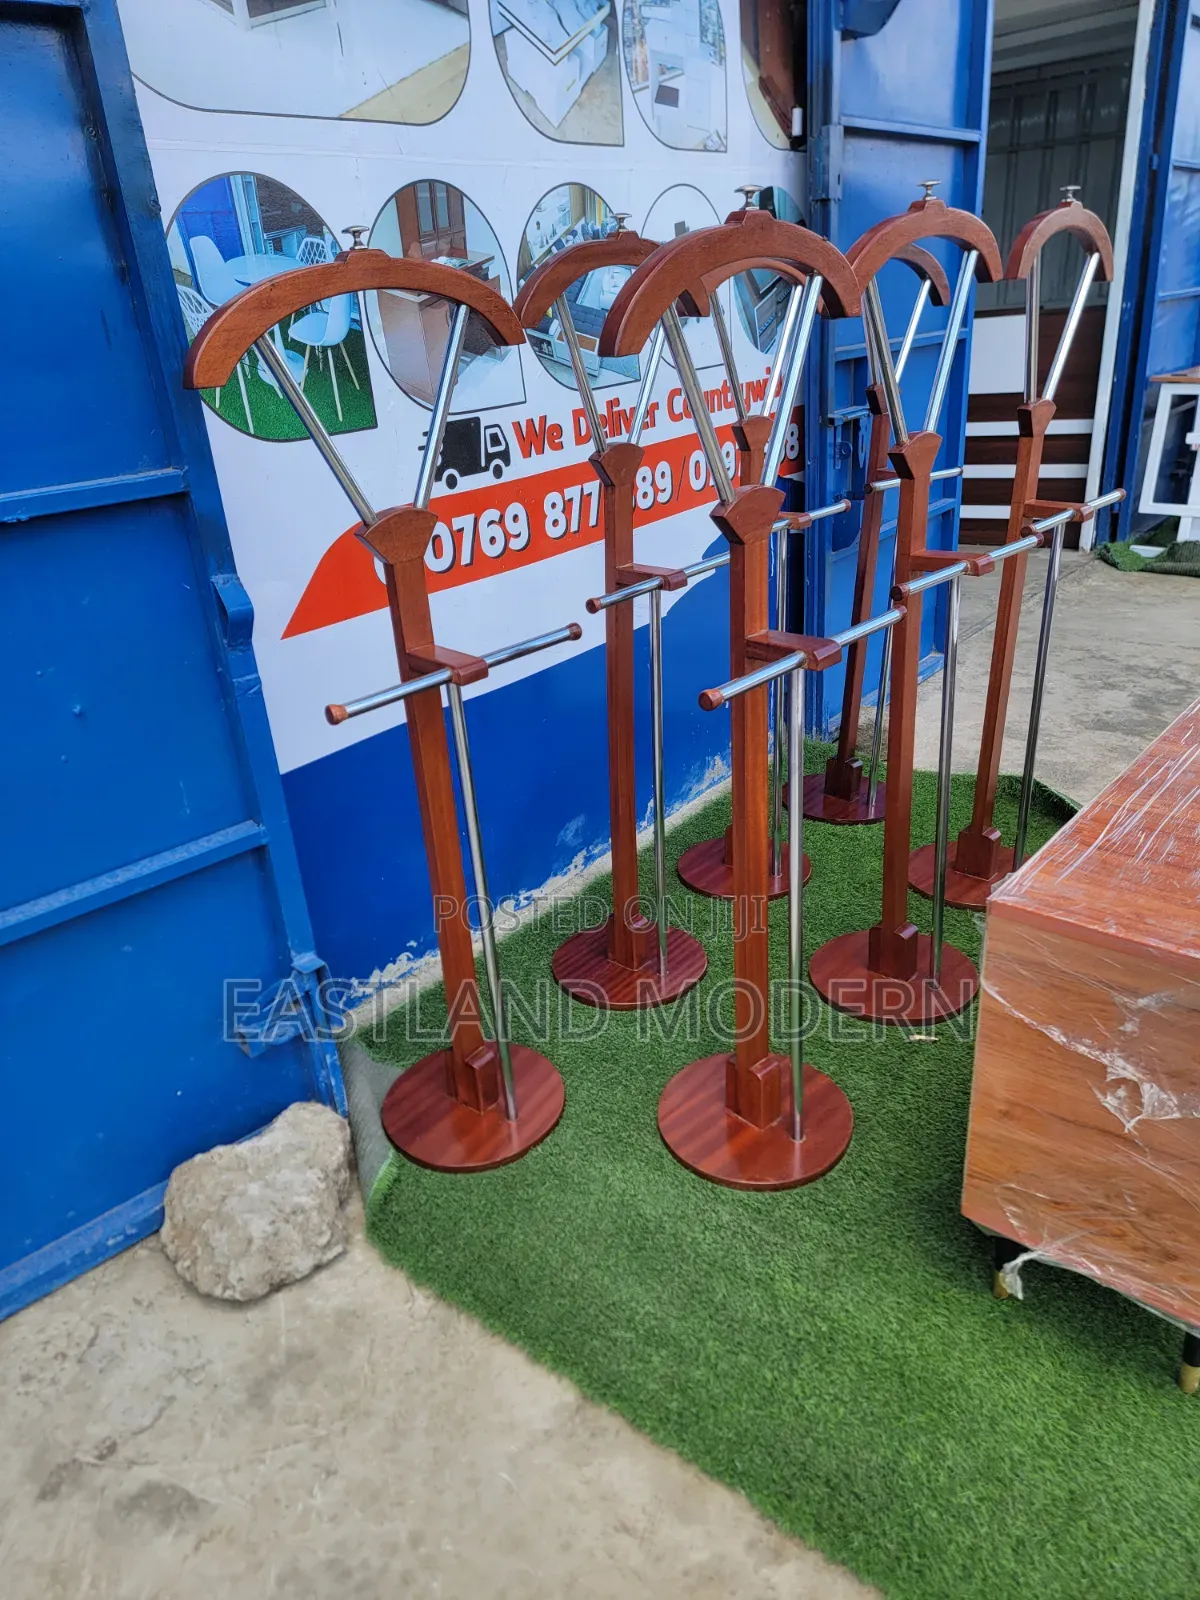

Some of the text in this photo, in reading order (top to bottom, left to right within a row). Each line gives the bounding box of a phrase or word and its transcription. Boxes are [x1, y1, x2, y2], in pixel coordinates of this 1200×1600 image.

[511, 414, 564, 459] We
[424, 502, 530, 574] 0769
[543, 480, 603, 540] 877
[632, 460, 673, 511] 89
